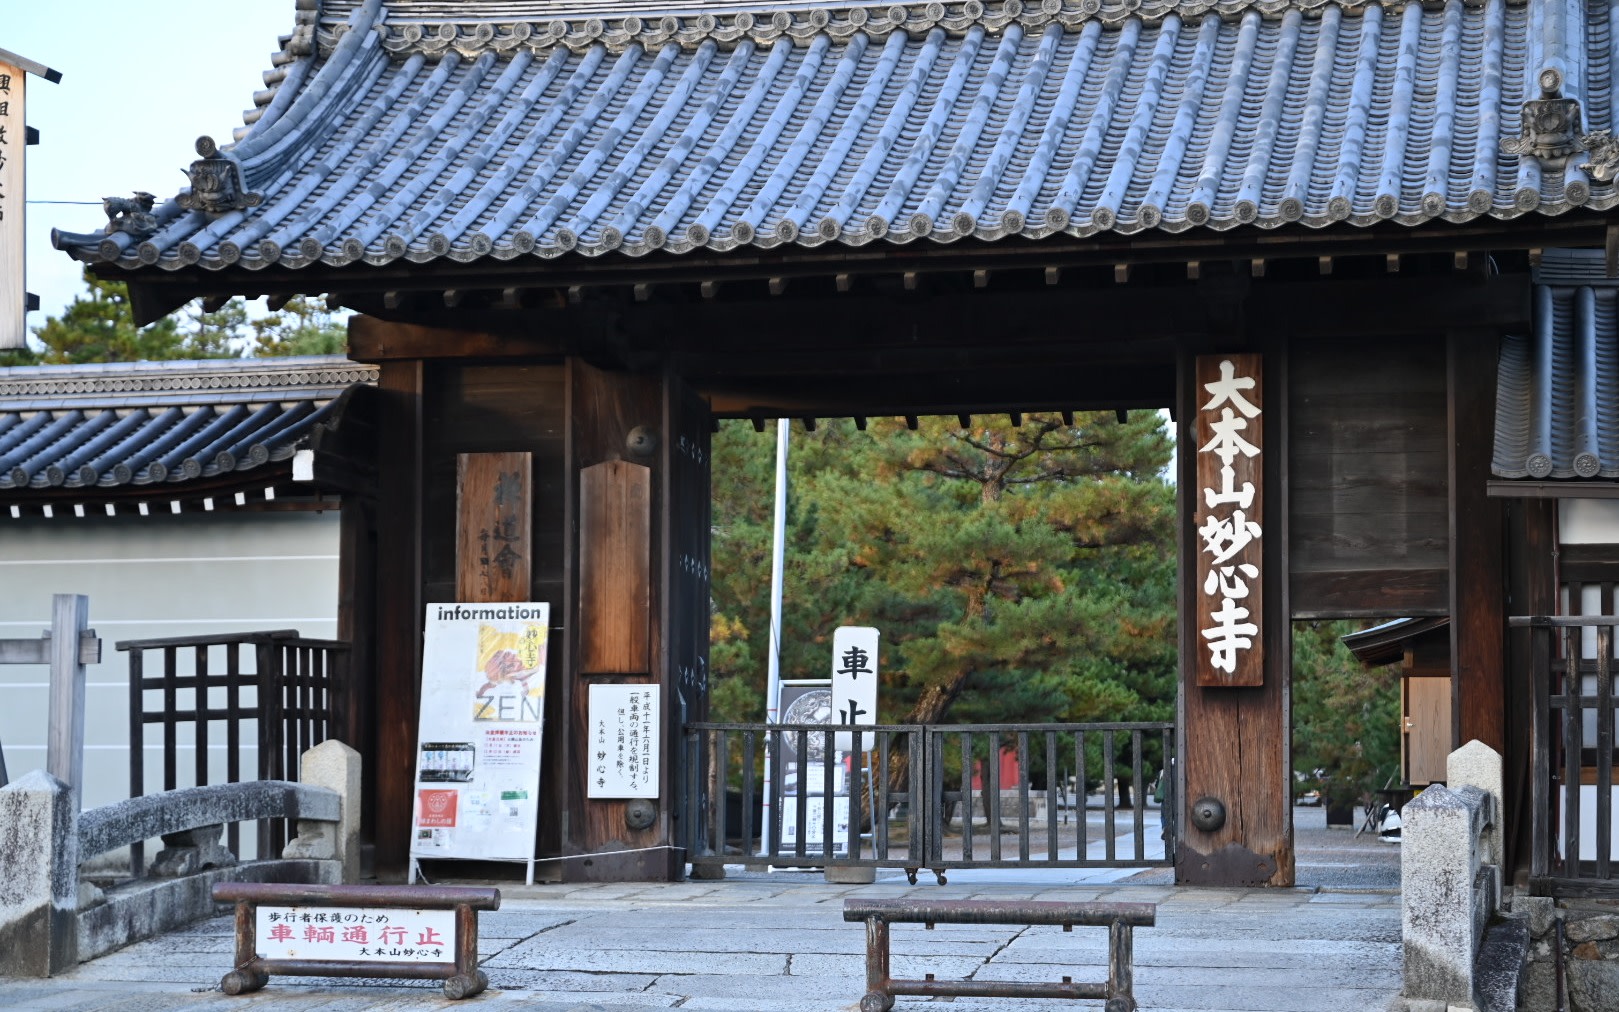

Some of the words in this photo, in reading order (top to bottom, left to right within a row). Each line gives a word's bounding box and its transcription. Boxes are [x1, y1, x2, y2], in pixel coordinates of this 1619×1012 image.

[1198, 359, 1263, 674] 大本山妙心寺
[438, 605, 541, 621] information
[474, 695, 541, 721] ZEN
[268, 912, 390, 924] 歩行者保護のため
[359, 947, 443, 958] 大本山妙心寺
